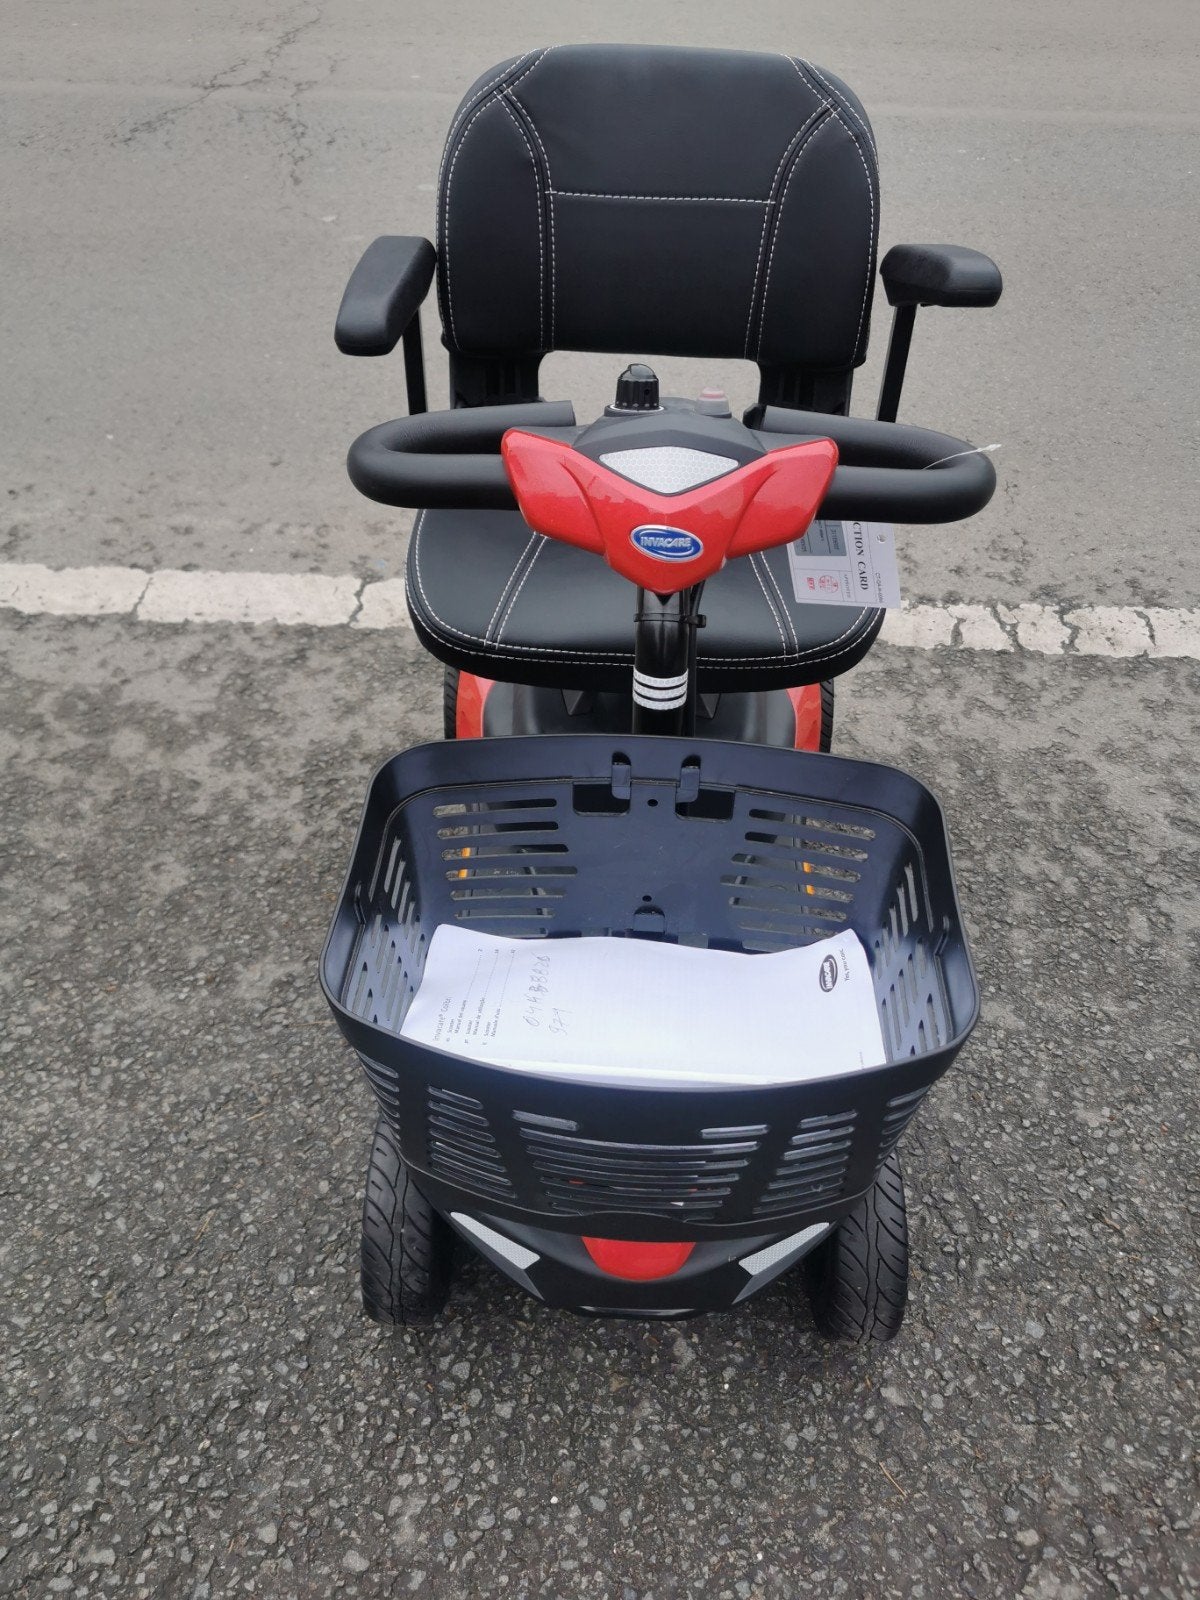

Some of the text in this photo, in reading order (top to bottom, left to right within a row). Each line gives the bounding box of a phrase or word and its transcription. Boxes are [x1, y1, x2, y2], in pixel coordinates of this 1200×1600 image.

[640, 536, 691, 548] INVACARE
[853, 522, 869, 591] CTION CARD
